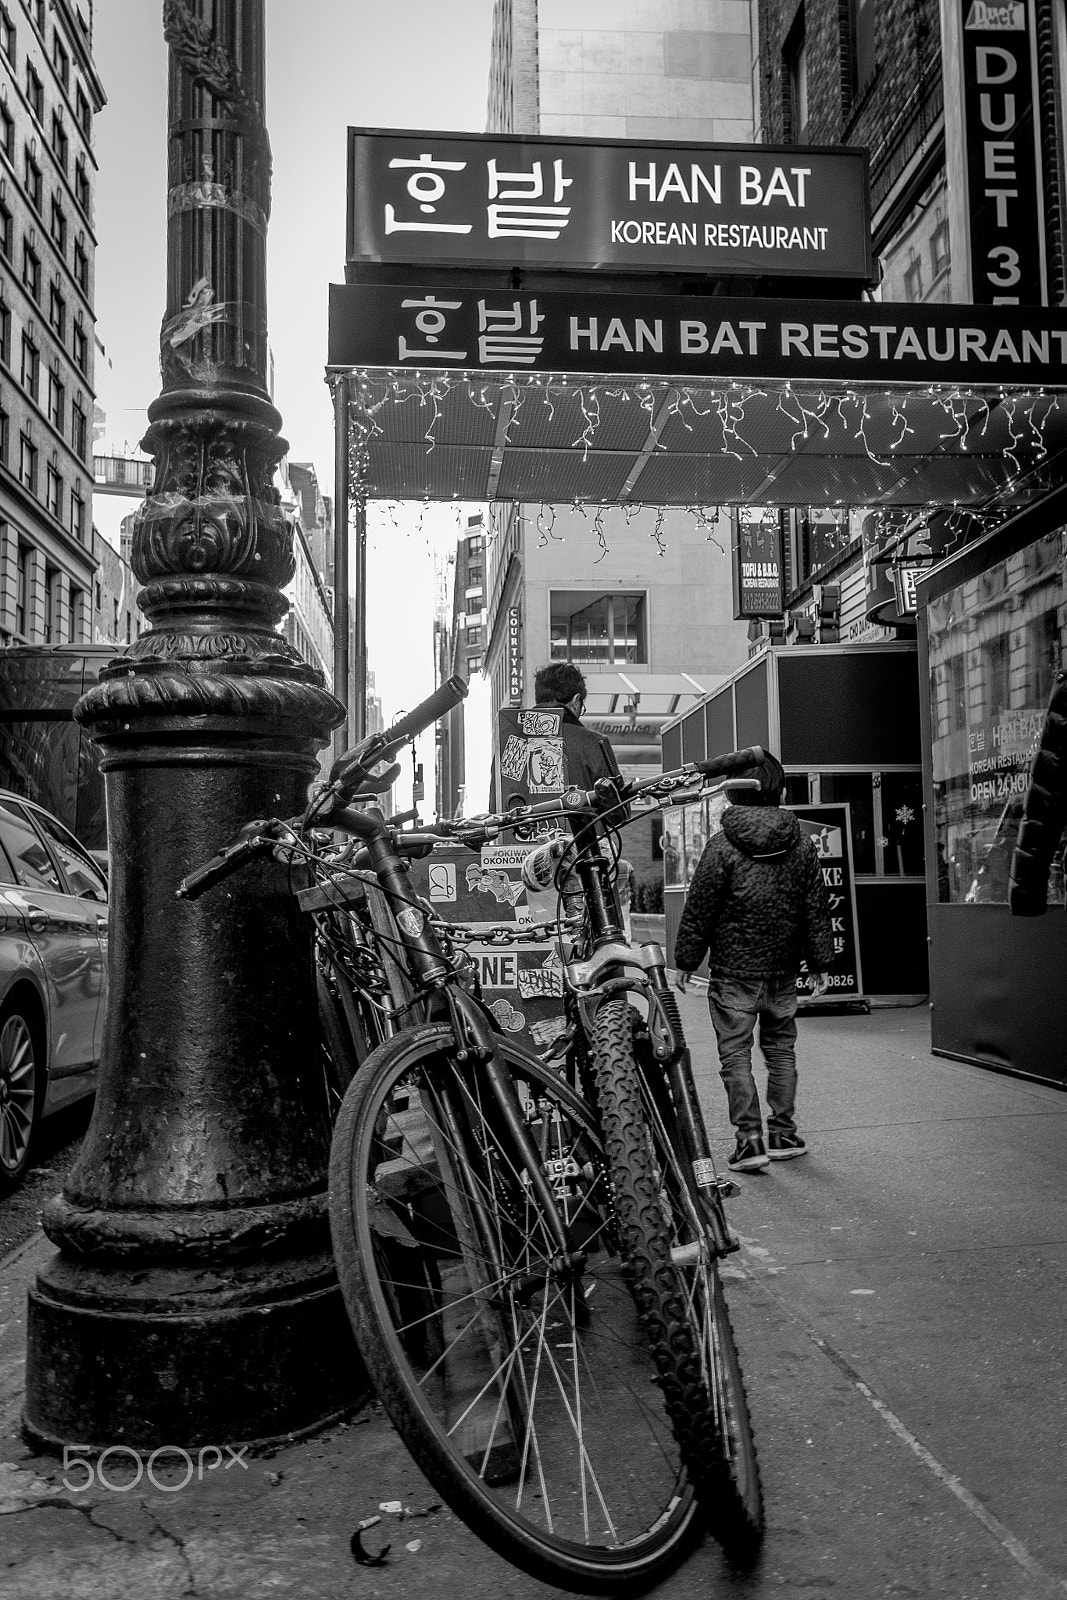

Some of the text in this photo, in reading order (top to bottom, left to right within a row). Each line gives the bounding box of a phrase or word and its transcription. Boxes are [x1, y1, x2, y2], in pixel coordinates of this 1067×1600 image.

[628, 161, 812, 208] HAN BAT
[976, 47, 1021, 306] DUET 3
[611, 220, 829, 250] KOREAN RESTAURANT
[569, 316, 1067, 364] HAN BAT RESTAURANT
[742, 562, 757, 577] TOFU
[509, 608, 519, 696] COURTYARD
[993, 719, 1018, 747] HAN
[1020, 711, 1044, 740] BAT
[970, 755, 997, 775] KOREAN
[971, 772, 1031, 801] OPEN 24 HOU
